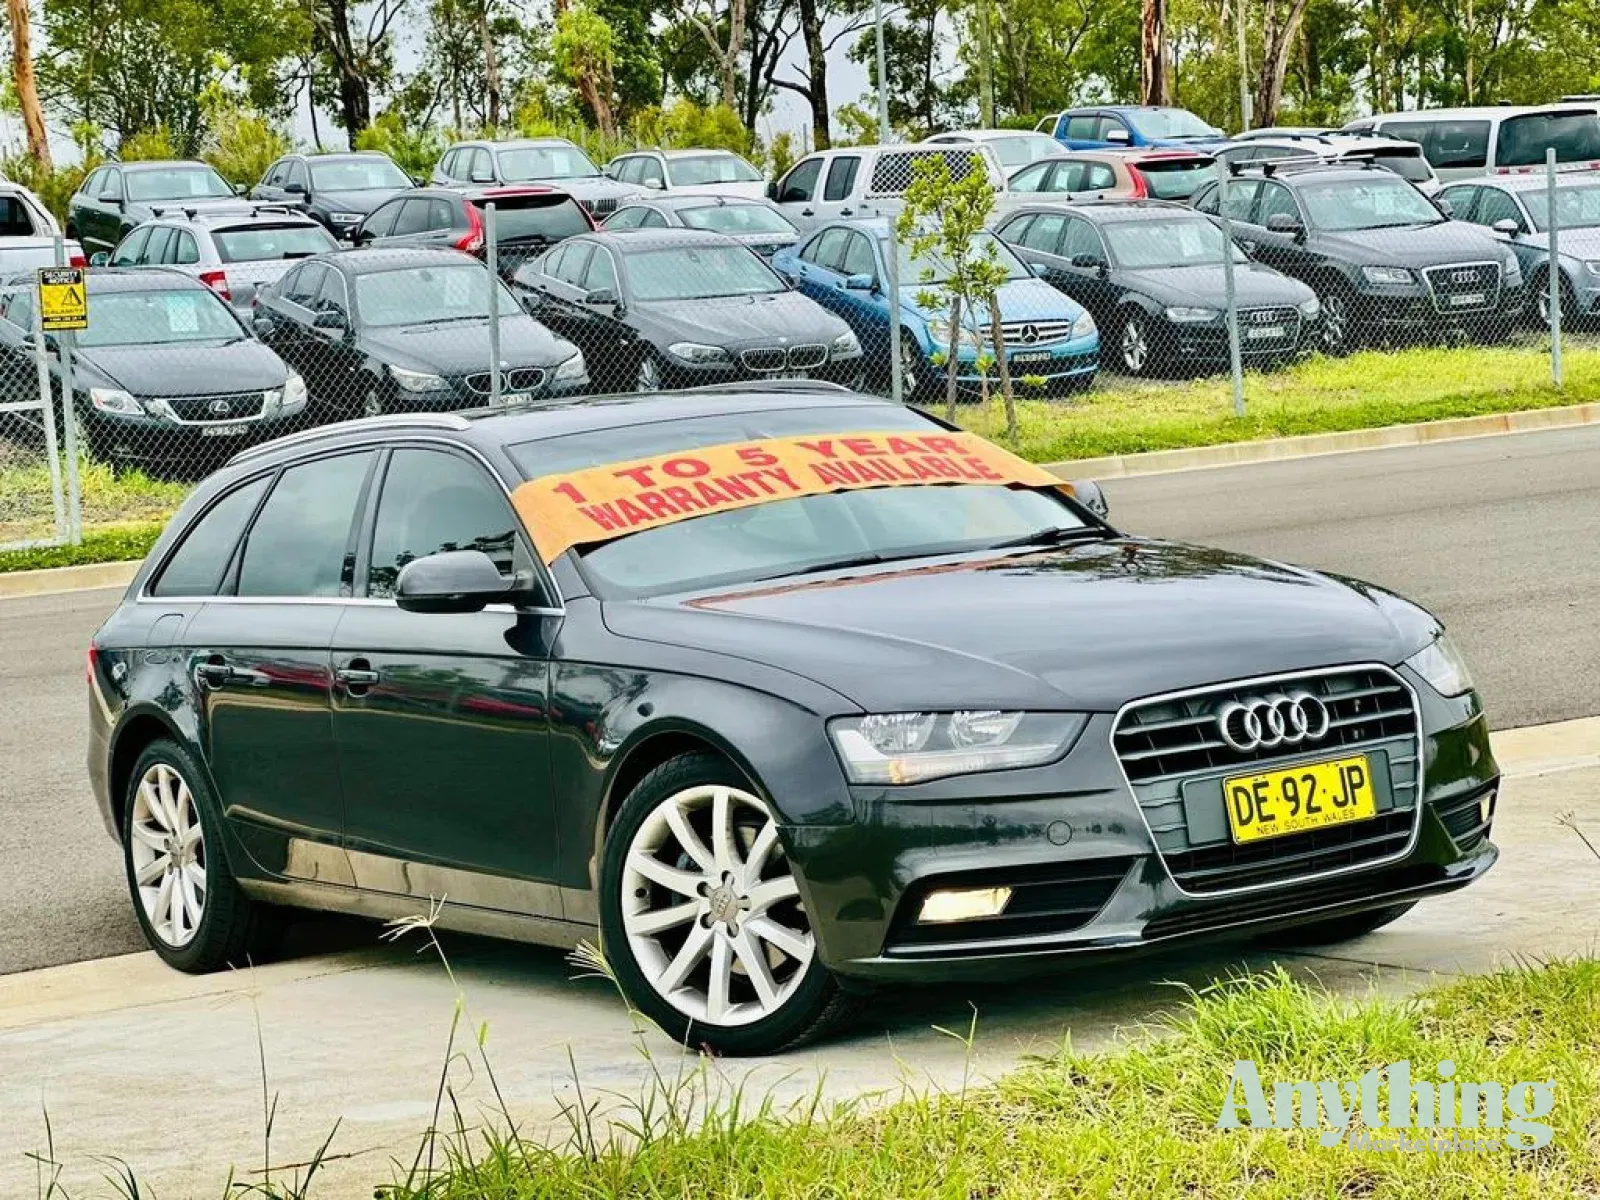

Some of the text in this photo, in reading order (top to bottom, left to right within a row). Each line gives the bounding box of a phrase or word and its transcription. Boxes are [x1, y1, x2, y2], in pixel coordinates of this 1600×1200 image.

[44, 271, 78, 279] SECURITY
[551, 436, 970, 504] 1 TO 5 YEAR
[576, 455, 1005, 531] WARRANTY AVAILABLE
[1256, 809, 1356, 835] NEW SOUTH WALES
